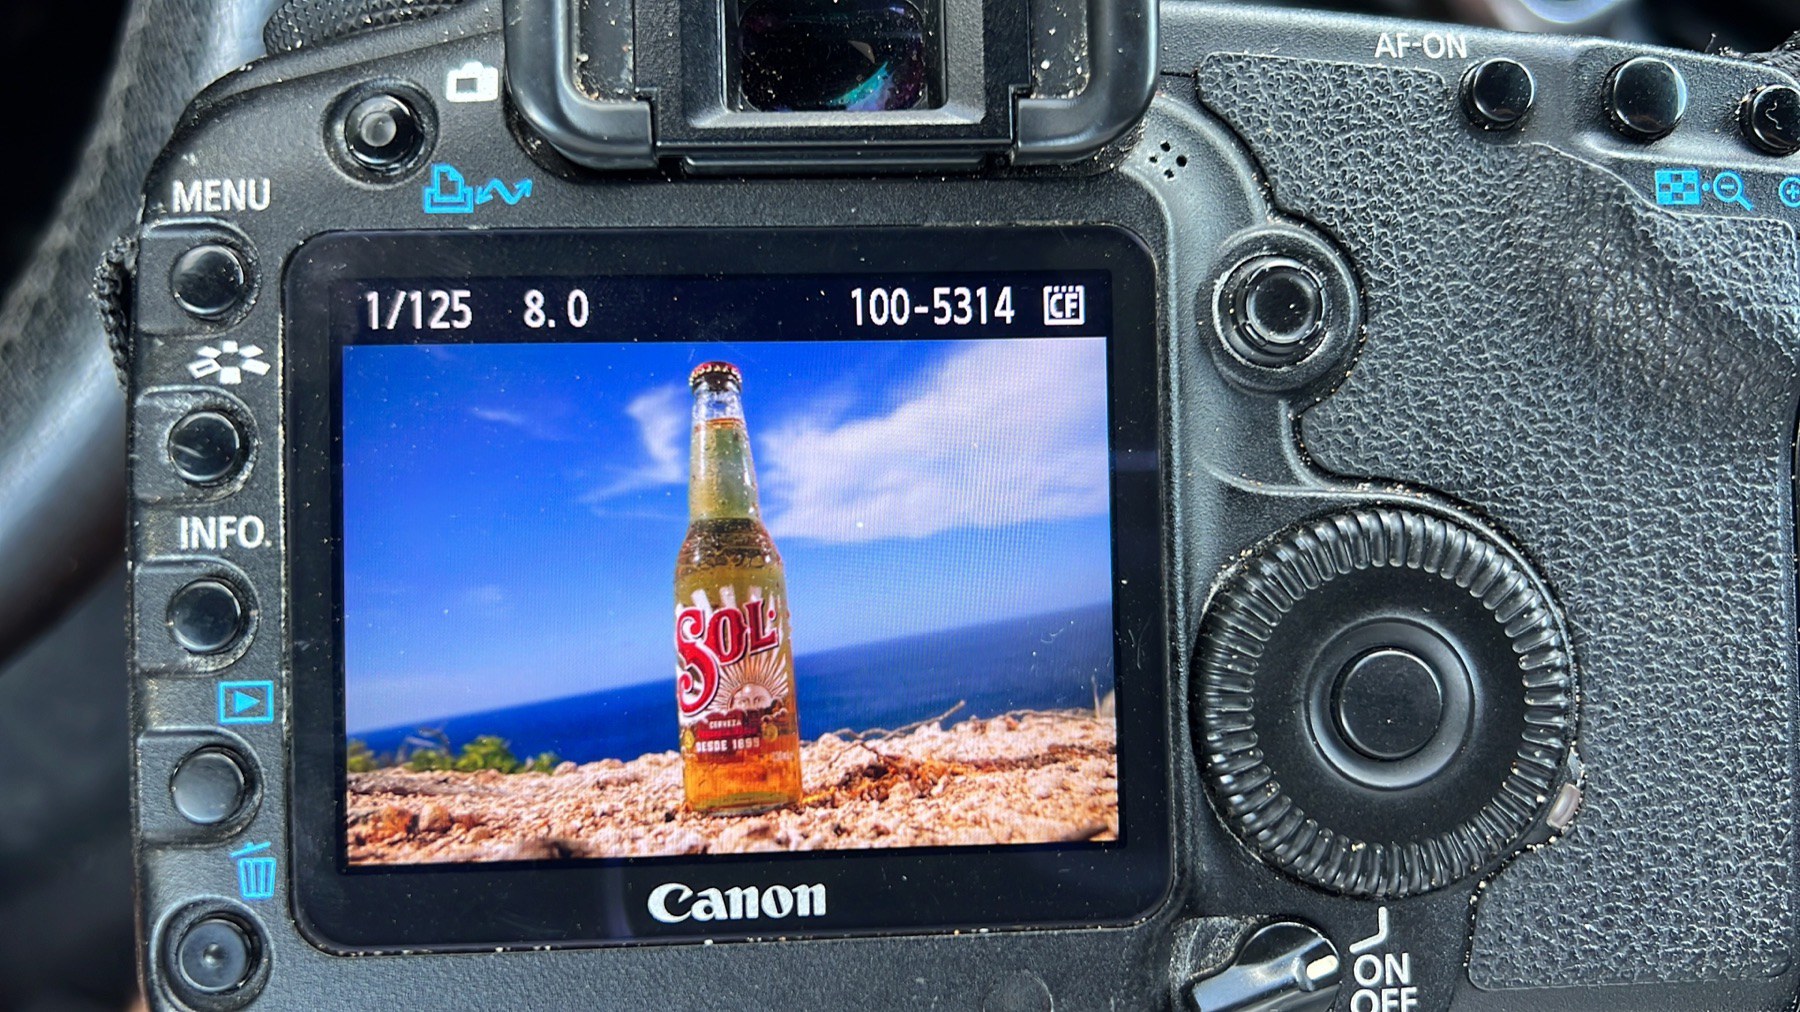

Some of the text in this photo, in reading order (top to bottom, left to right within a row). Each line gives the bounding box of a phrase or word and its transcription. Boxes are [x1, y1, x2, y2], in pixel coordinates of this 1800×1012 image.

[1374, 31, 1468, 59] AF-ON
[172, 177, 271, 213] MENU
[366, 286, 1079, 330] 1/125 8.0 100-5314 CF
[708, 718, 742, 730] CERVEZA
[695, 739, 728, 752] DESDE
[648, 882, 826, 923] Canon
[1353, 952, 1411, 987] ON
[1350, 987, 1418, 1012] OFF
